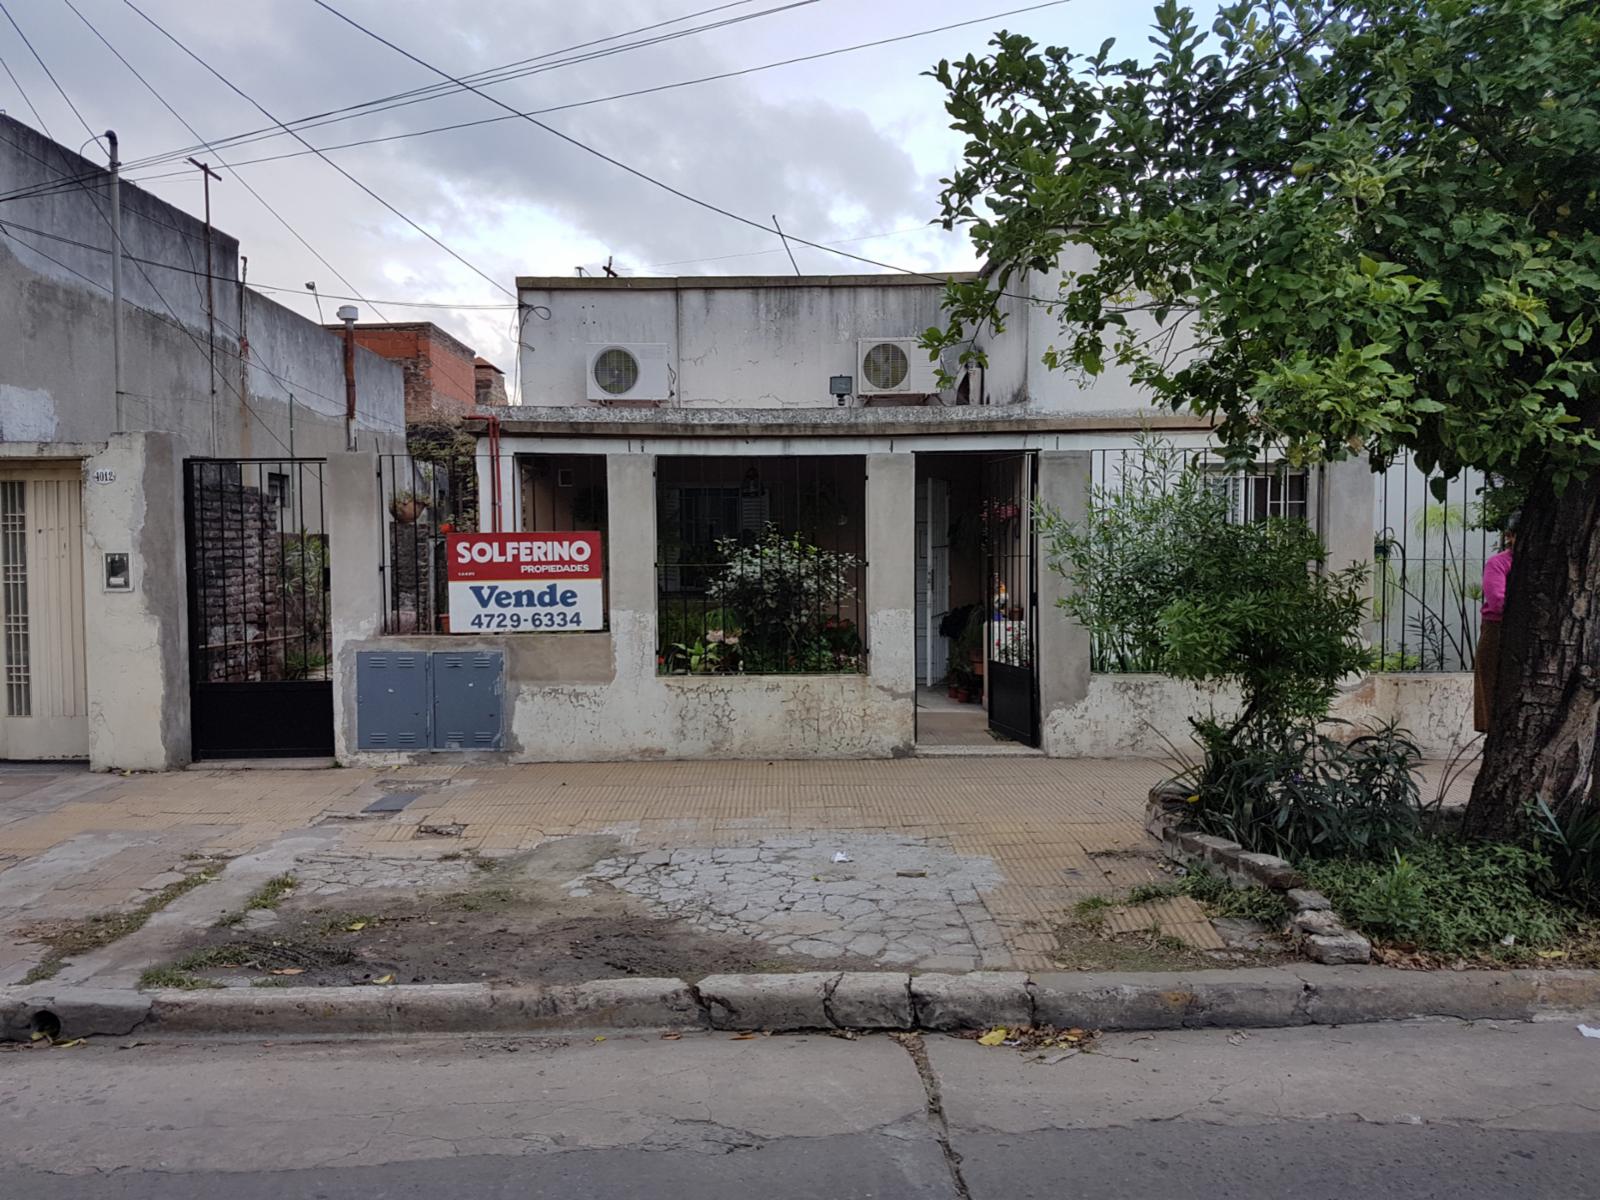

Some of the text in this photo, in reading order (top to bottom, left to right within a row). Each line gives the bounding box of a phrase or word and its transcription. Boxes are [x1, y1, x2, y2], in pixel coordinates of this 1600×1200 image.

[93, 470, 114, 482] 4012
[456, 540, 592, 564] SOLFERINO
[520, 564, 590, 573] PROPIEDADES
[469, 583, 578, 609] Vende
[470, 612, 582, 629] 4729-6334
